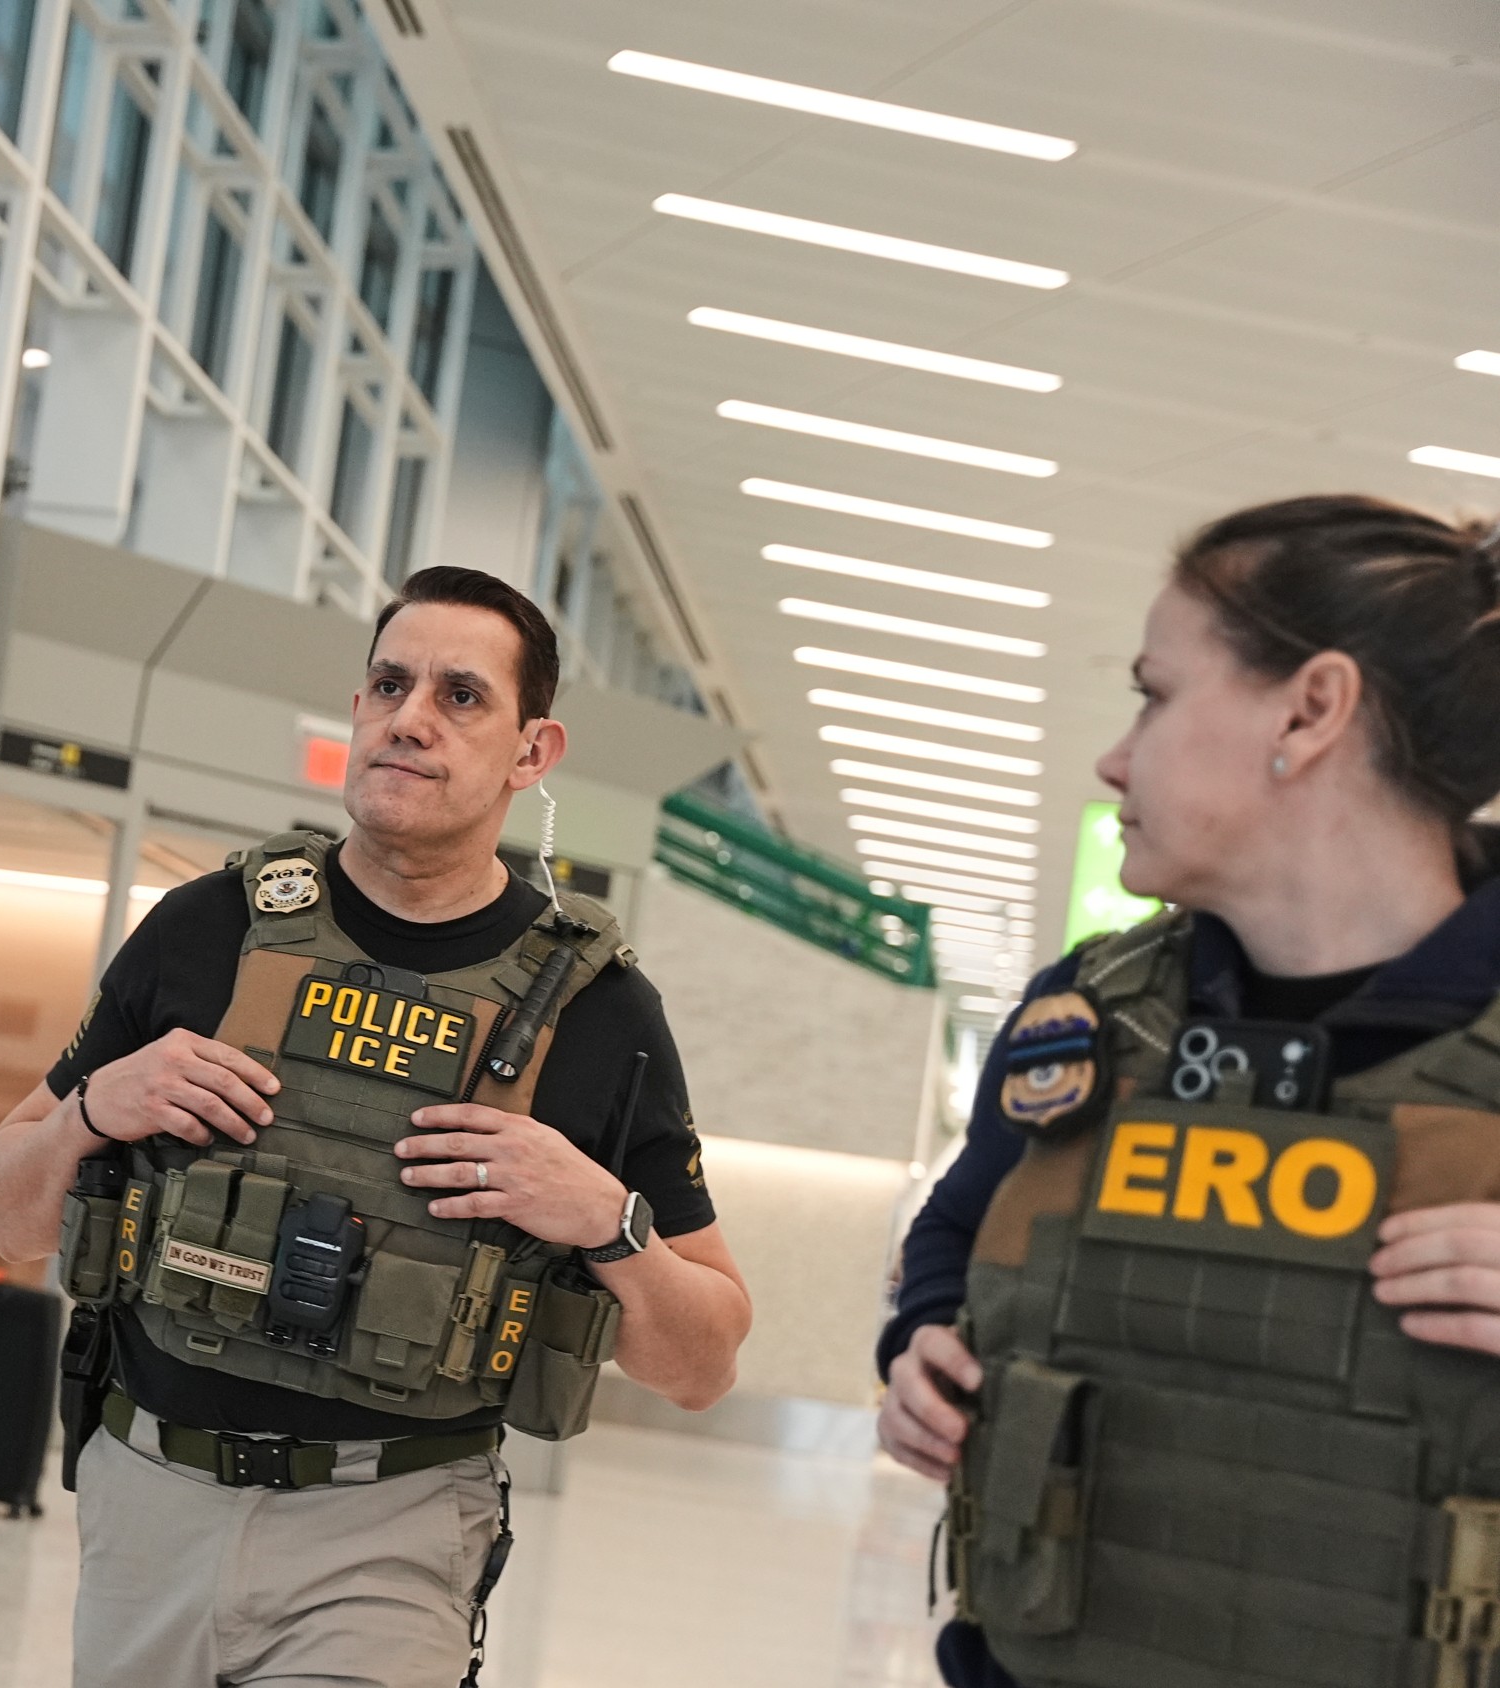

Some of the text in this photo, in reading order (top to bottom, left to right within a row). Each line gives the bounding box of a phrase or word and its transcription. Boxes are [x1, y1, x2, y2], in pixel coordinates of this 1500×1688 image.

[301, 981, 466, 1055] POLICE
[328, 1030, 417, 1079] ICE
[1097, 1121, 1378, 1240] ERO
[119, 1187, 143, 1273] ERO
[169, 1246, 265, 1282] IN GOD WE TRUST
[491, 1289, 532, 1373] ERO
